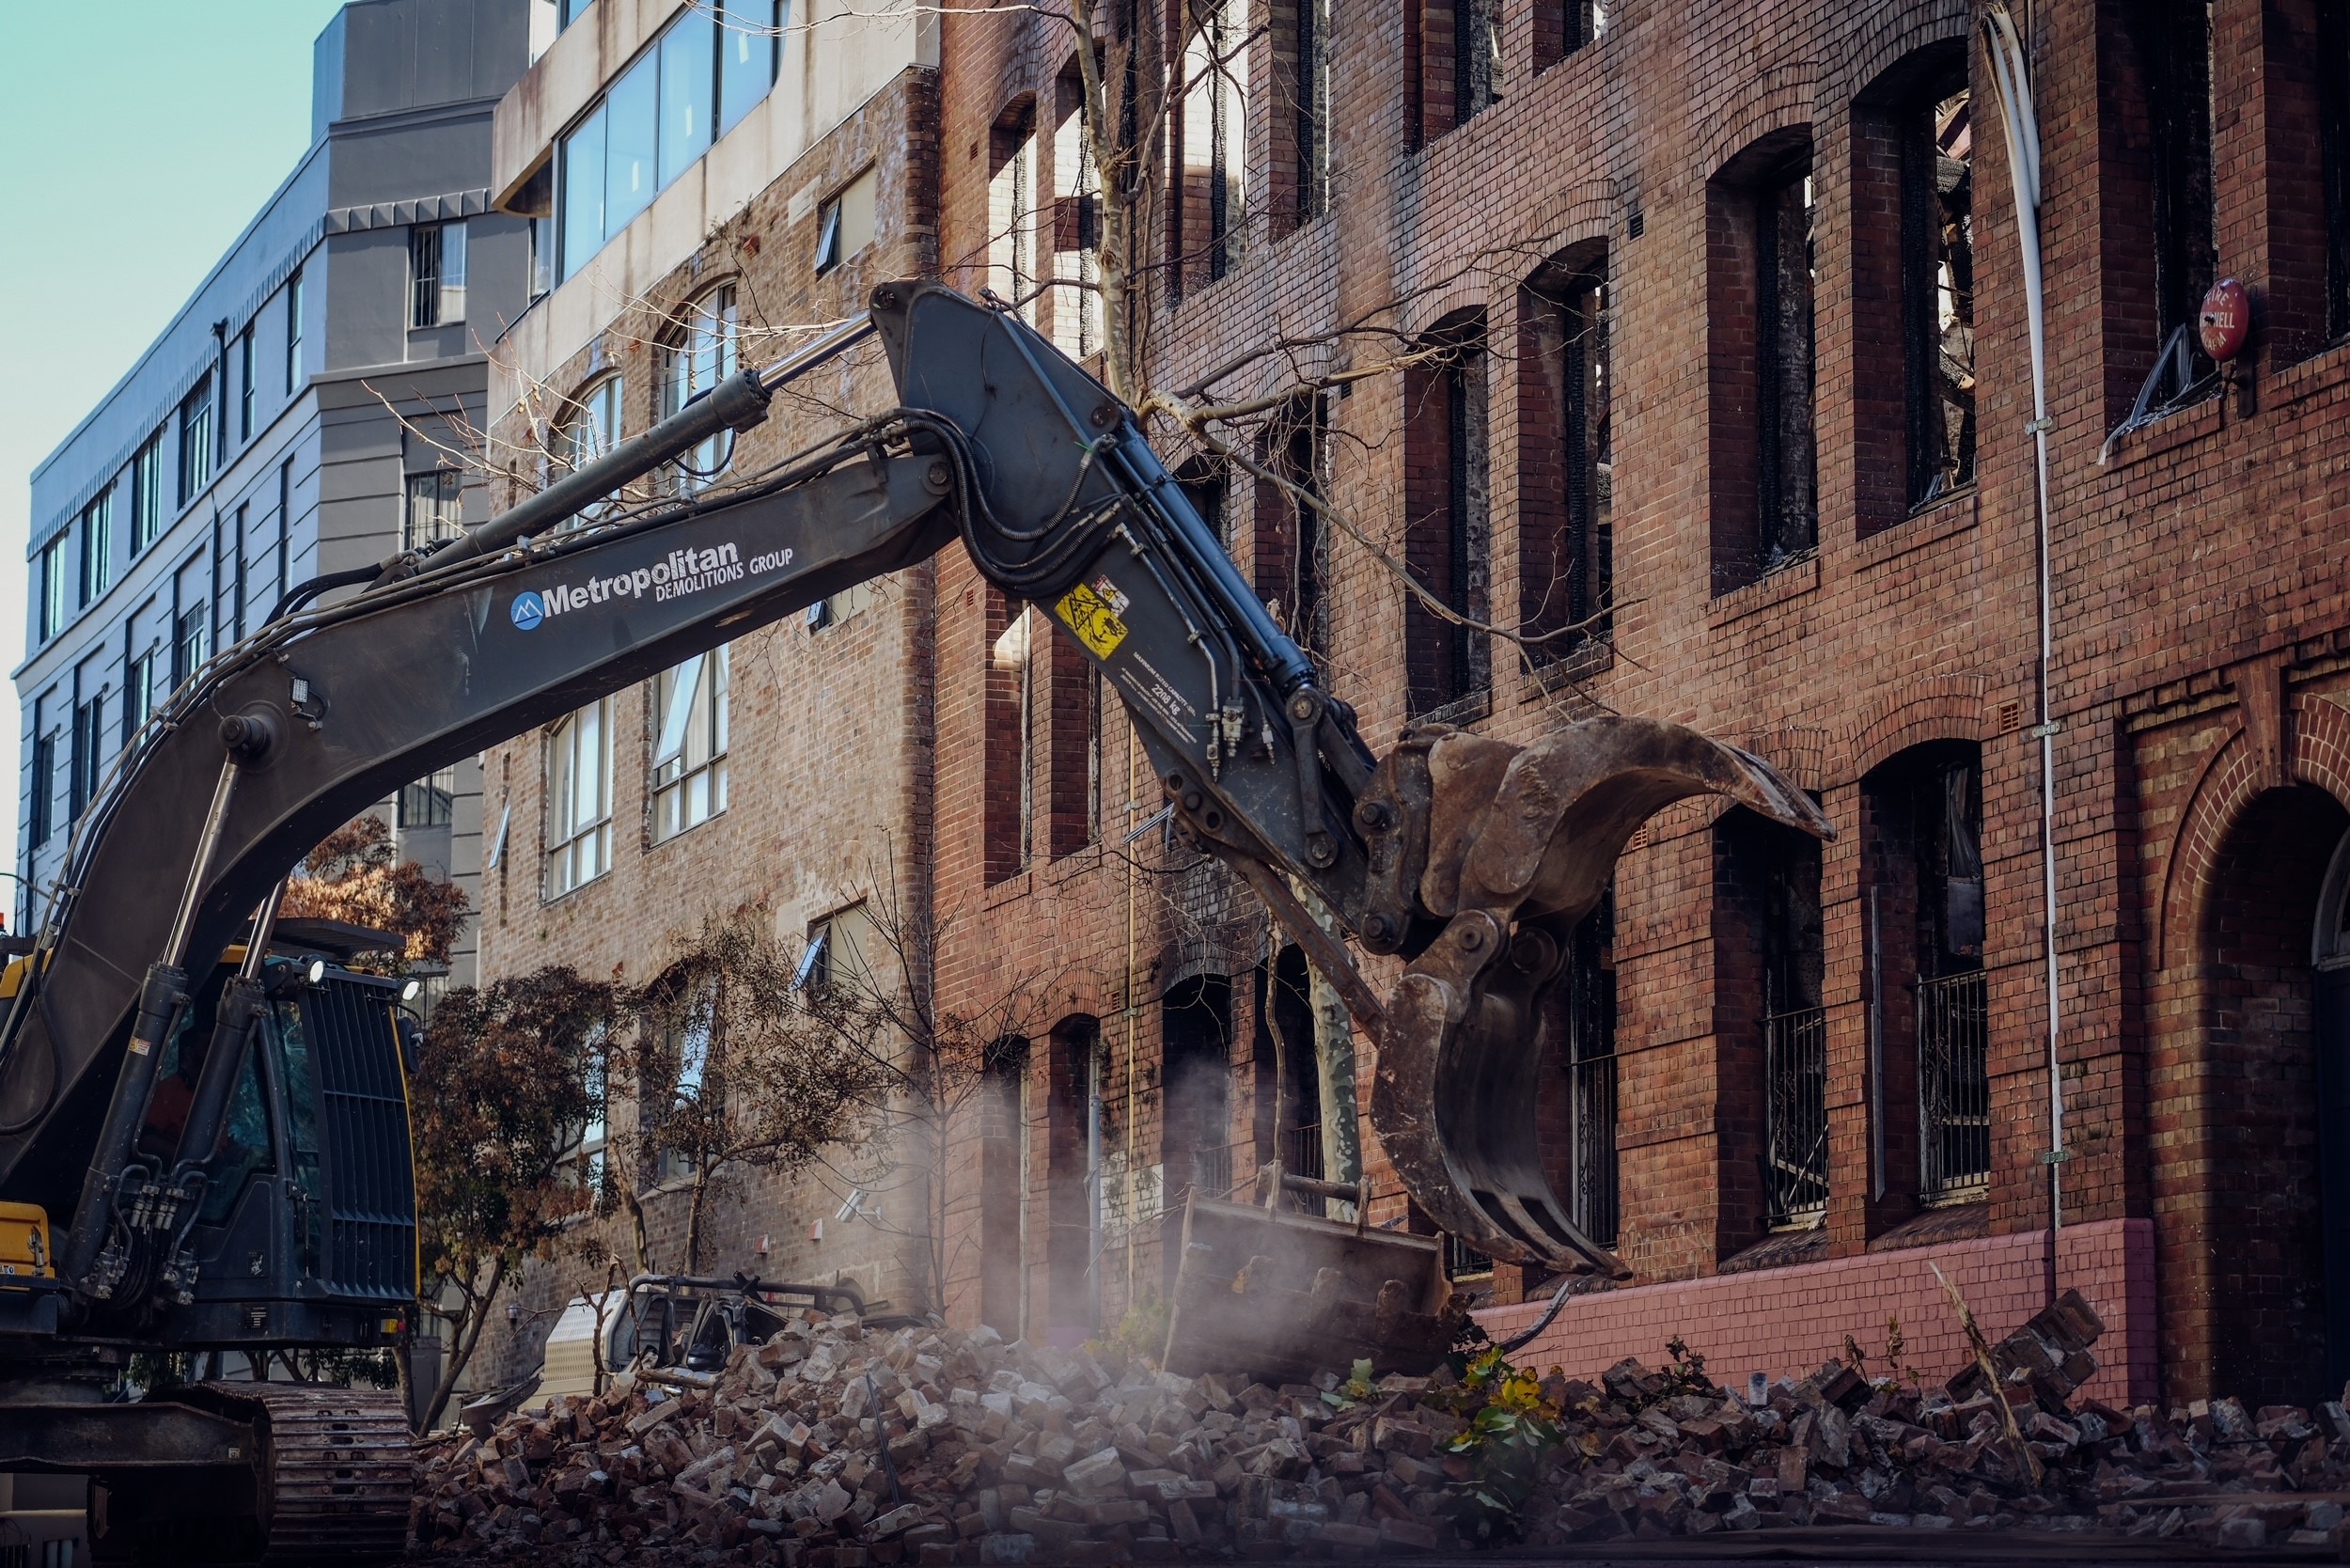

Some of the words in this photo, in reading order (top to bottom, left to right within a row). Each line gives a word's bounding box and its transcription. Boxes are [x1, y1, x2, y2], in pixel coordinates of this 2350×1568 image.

[2204, 286, 2229, 306] FIRE
[541, 541, 739, 618] Metropolitan
[655, 561, 744, 603] DEMOLITIONS
[749, 547, 794, 574] GROUP
[1152, 683, 1172, 704] 2208
[1168, 700, 1182, 715] kg
